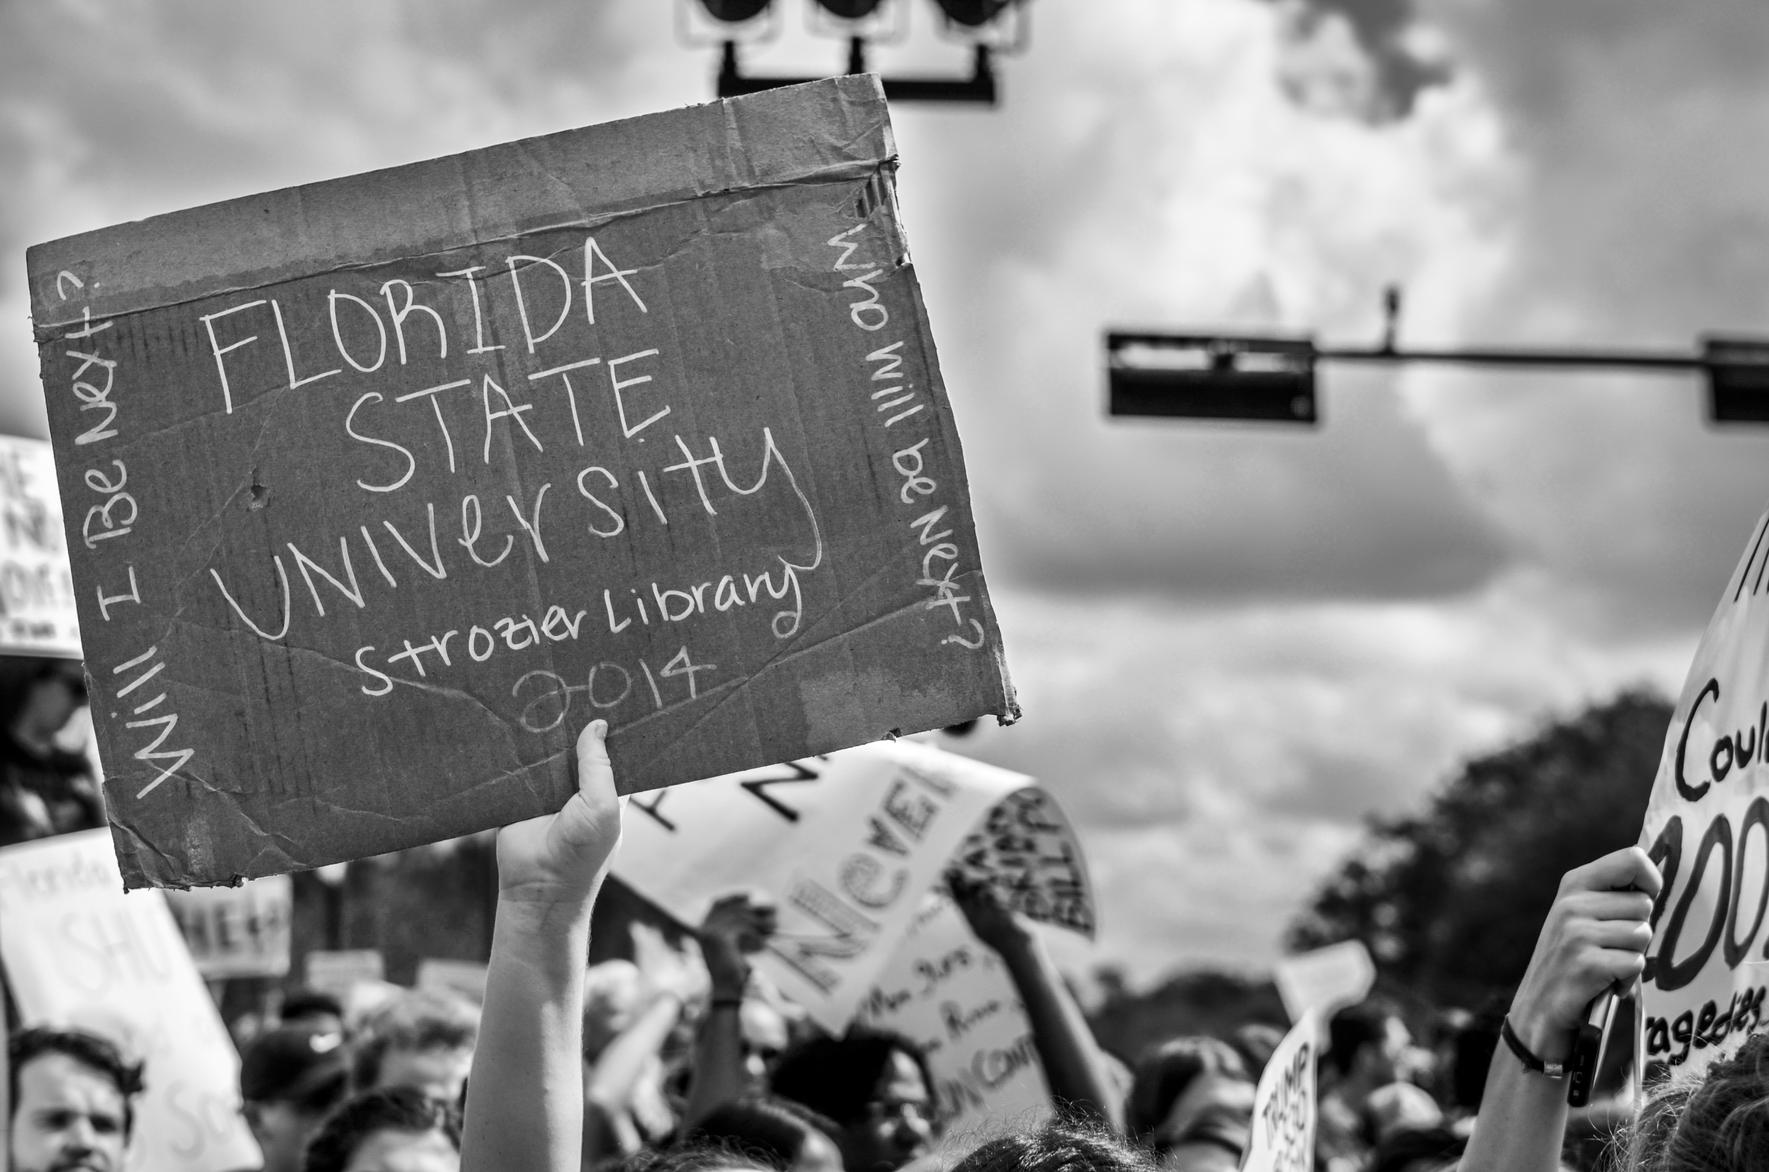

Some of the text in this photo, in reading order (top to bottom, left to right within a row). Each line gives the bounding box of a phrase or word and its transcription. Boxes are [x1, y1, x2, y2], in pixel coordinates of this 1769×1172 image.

[200, 236, 648, 415] FLORIDA
[826, 222, 890, 332] Who
[346, 348, 671, 493] STATE
[83, 459, 138, 549] Be
[96, 565, 141, 622] I
[111, 645, 196, 800] Will
[511, 645, 718, 733] 2014
[1674, 677, 1769, 802] Coul
